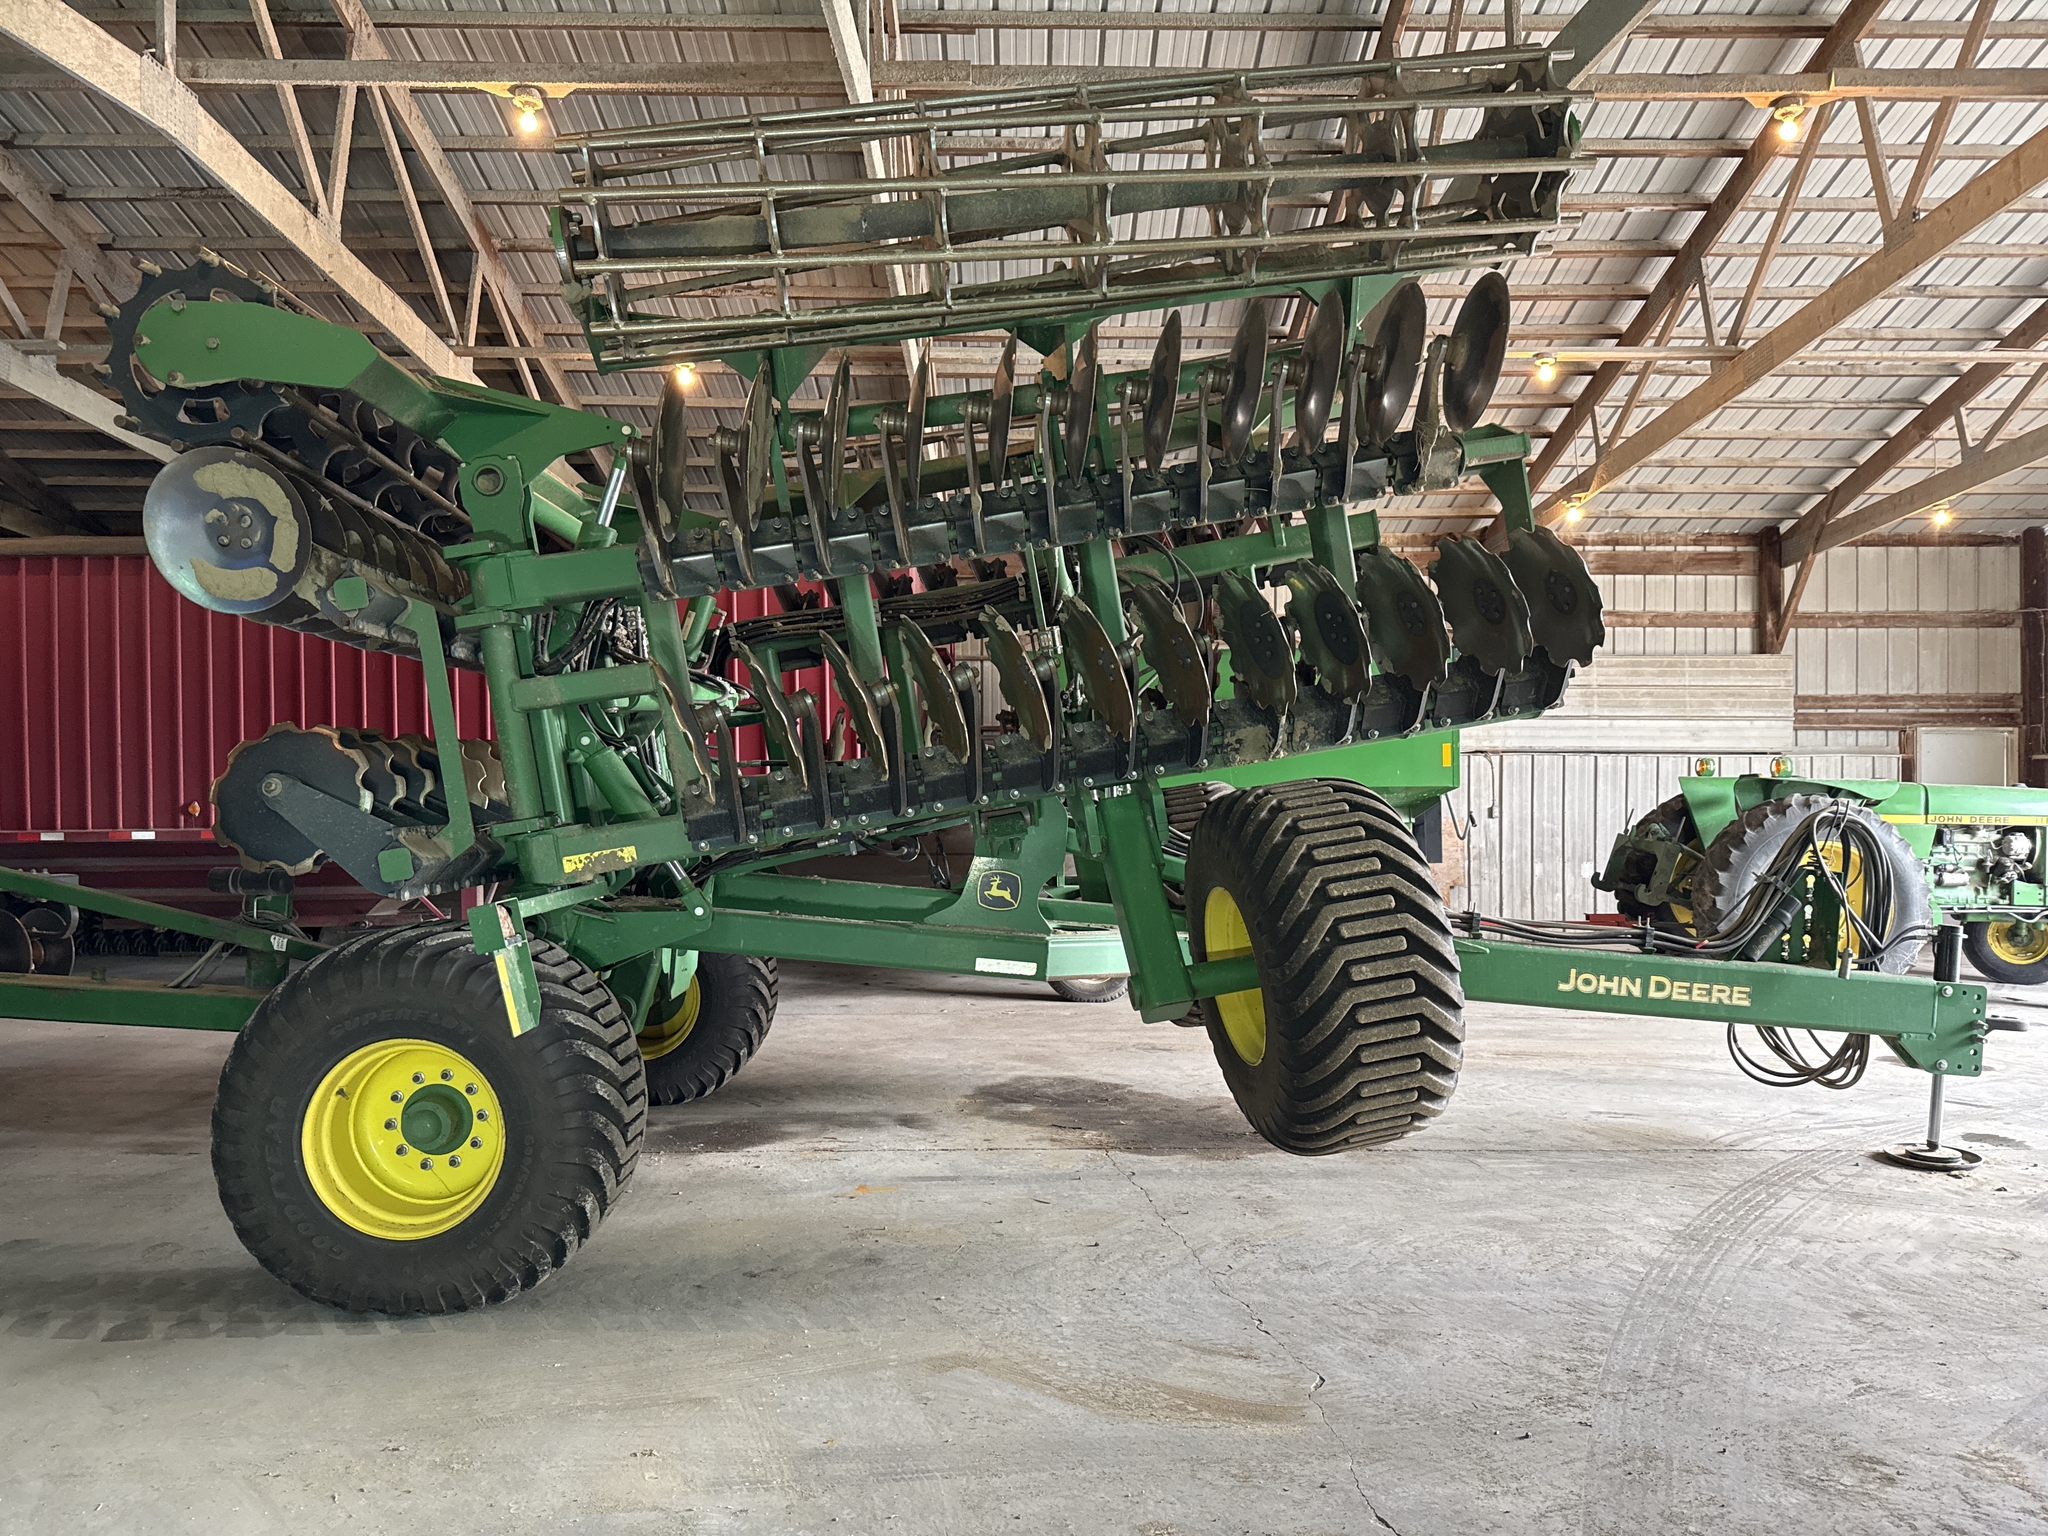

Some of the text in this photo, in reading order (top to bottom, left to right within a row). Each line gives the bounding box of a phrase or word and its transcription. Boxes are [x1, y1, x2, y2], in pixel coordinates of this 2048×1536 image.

[1930, 815, 2010, 824] JOHN DEERE
[1557, 967, 1752, 1007] JOHN DEERE
